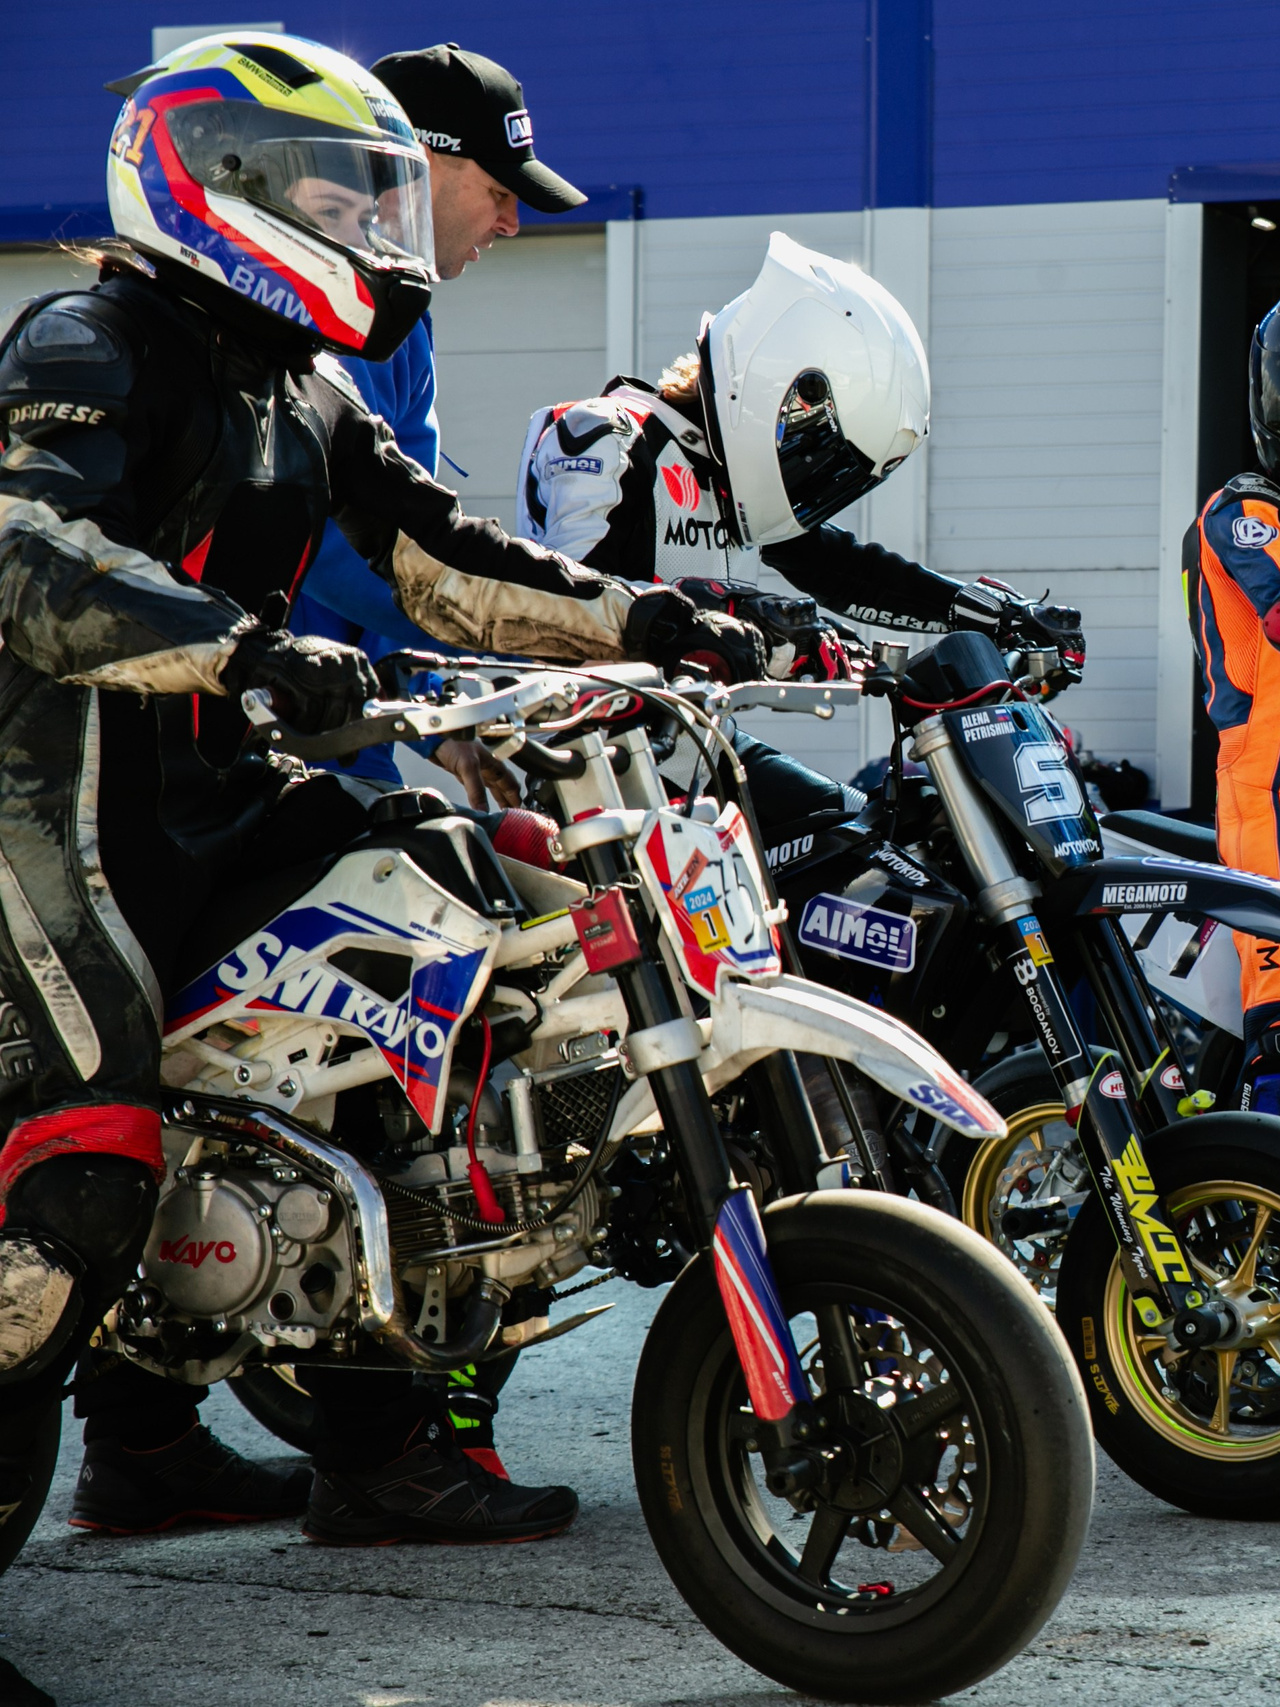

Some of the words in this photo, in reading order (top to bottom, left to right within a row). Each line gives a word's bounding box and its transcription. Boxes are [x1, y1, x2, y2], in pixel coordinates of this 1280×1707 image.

[228, 264, 314, 327] BMW
[961, 711, 990, 729] ALENA
[963, 721, 1016, 743] PETRISHINA
[1013, 741, 1085, 826] 5
[688, 891, 713, 910] 2024
[1102, 884, 1188, 904] MEGAMOTO
[701, 910, 718, 939] 1
[804, 904, 908, 961] AIMOL
[1023, 919, 1041, 932] 202
[1034, 932, 1049, 955] 1
[1026, 986, 1061, 1055] BOGDANOV
[1100, 1165, 1114, 1190] The
[1110, 1192, 1133, 1243] Winning
[1131, 1245, 1148, 1280] Tyres
[158, 1234, 237, 1269] KAYO
